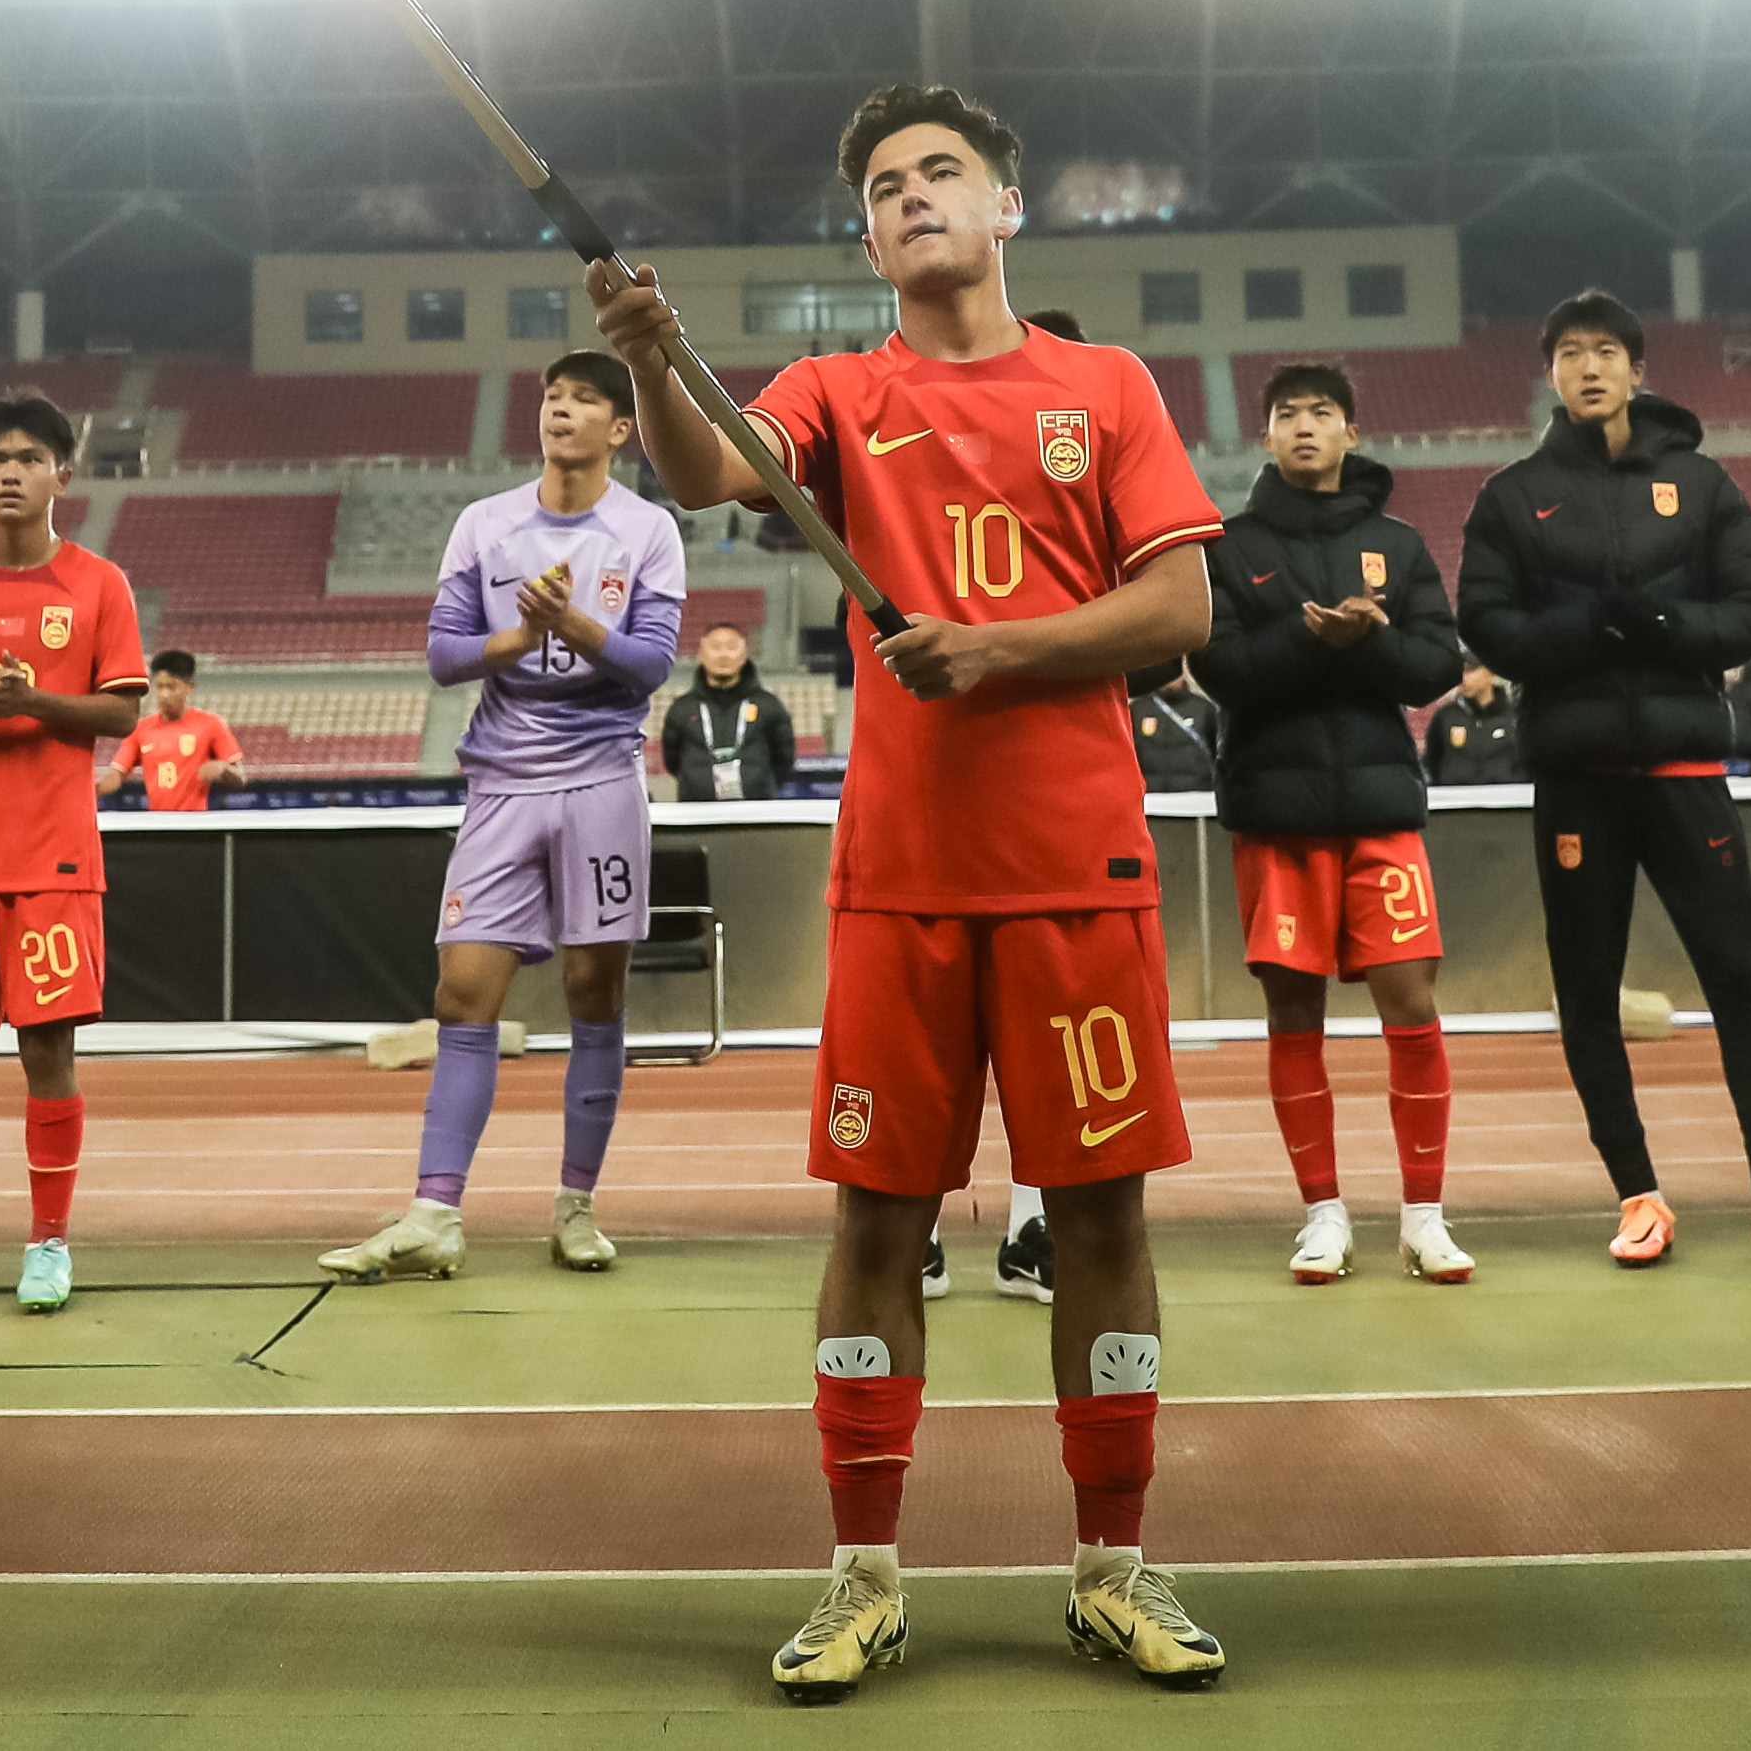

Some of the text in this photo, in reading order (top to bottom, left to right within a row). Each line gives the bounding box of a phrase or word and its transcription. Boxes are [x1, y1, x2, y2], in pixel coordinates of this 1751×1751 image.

[1042, 415, 1083, 429] CFA
[945, 502, 1024, 598] 10
[588, 854, 633, 907] 13
[1380, 863, 1429, 922] 21
[20, 922, 80, 985] 20
[1050, 1005, 1138, 1109] 10
[838, 1088, 869, 1105] CFA
